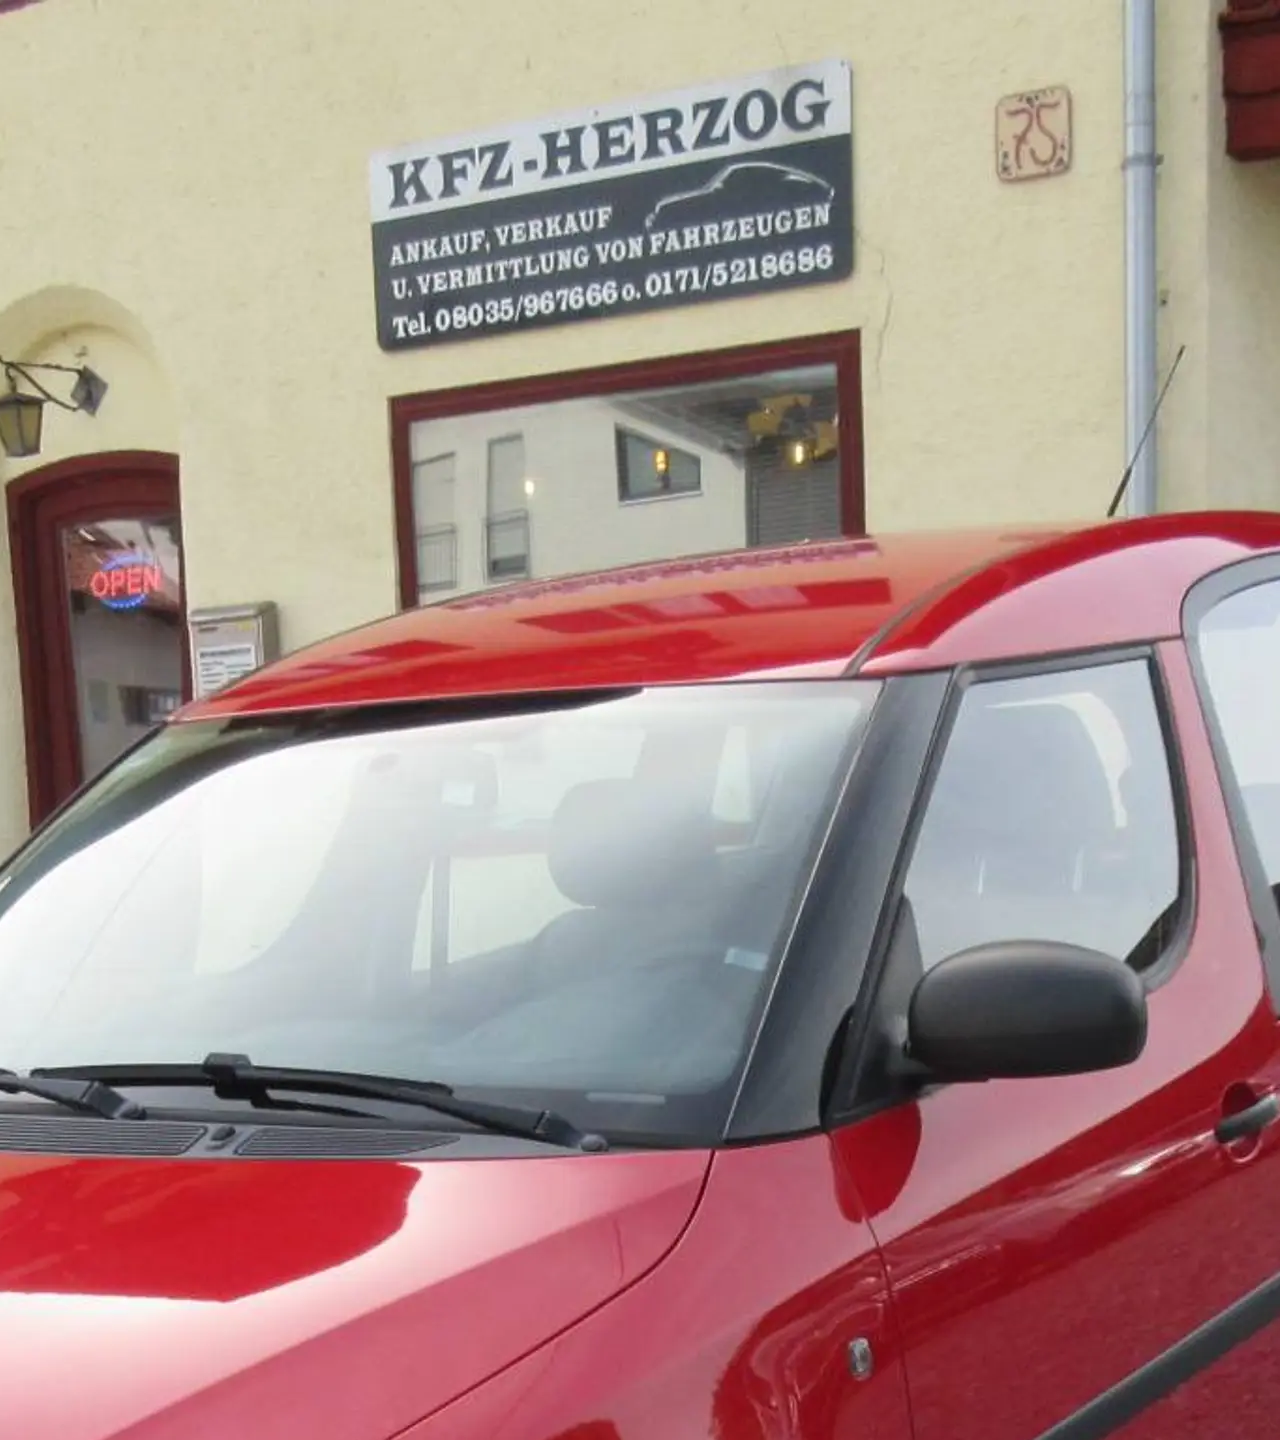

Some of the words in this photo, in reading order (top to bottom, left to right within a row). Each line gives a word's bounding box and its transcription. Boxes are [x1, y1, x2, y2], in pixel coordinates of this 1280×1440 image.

[388, 79, 831, 209] KFZ-HERZOG
[390, 230, 491, 267] ANKAUF,
[494, 206, 612, 247] VERKAUF
[392, 278, 412, 299] U.
[417, 248, 589, 295] VERMITTLUNG
[595, 236, 643, 265] VON
[650, 203, 831, 256] FAHRZEUGEN
[392, 312, 431, 339] Tel.
[435, 280, 618, 332] 08035/967666
[645, 244, 834, 297] 0171/5218686
[90, 565, 162, 598] OPEN
